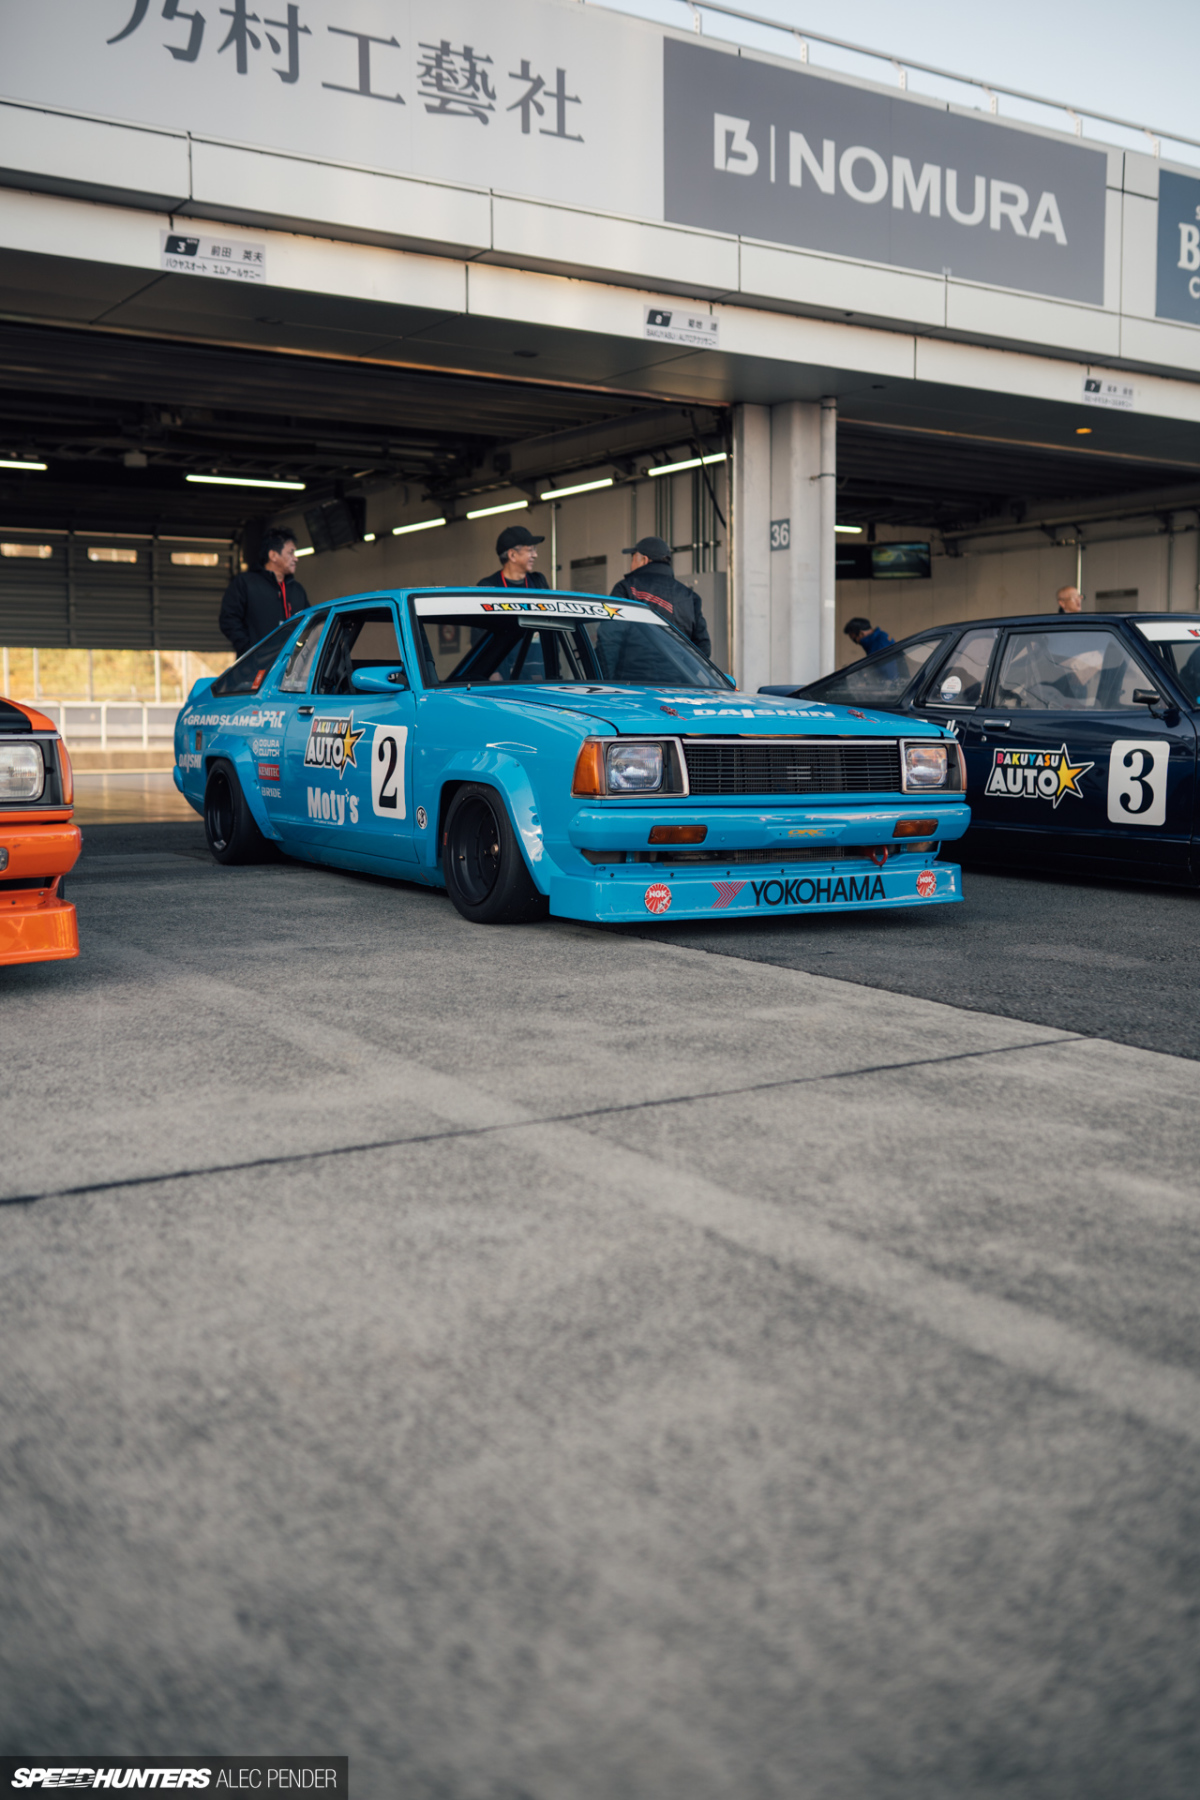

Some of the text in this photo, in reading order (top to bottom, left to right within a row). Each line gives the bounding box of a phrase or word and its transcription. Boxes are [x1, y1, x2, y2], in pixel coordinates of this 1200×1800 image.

[789, 130, 1068, 246] NOMURA
[176, 241, 186, 253] 3
[771, 523, 789, 547] 36
[481, 602, 608, 616] BAKUYASU AUTO
[312, 721, 348, 734] BAKUYASU
[259, 739, 280, 748] OGURA
[306, 736, 344, 765] AUTO
[259, 748, 280, 757] CLUTCH
[996, 753, 1060, 767] BAKUYASU
[259, 767, 280, 778] KEMITEC
[378, 736, 398, 809] 2
[989, 769, 1058, 795] AUTO
[1119, 749, 1155, 814] 3
[261, 787, 282, 798] BRIDE
[307, 786, 359, 825] Moty's
[649, 890, 667, 898] NGK
[751, 875, 886, 906] YOKOHAMA
